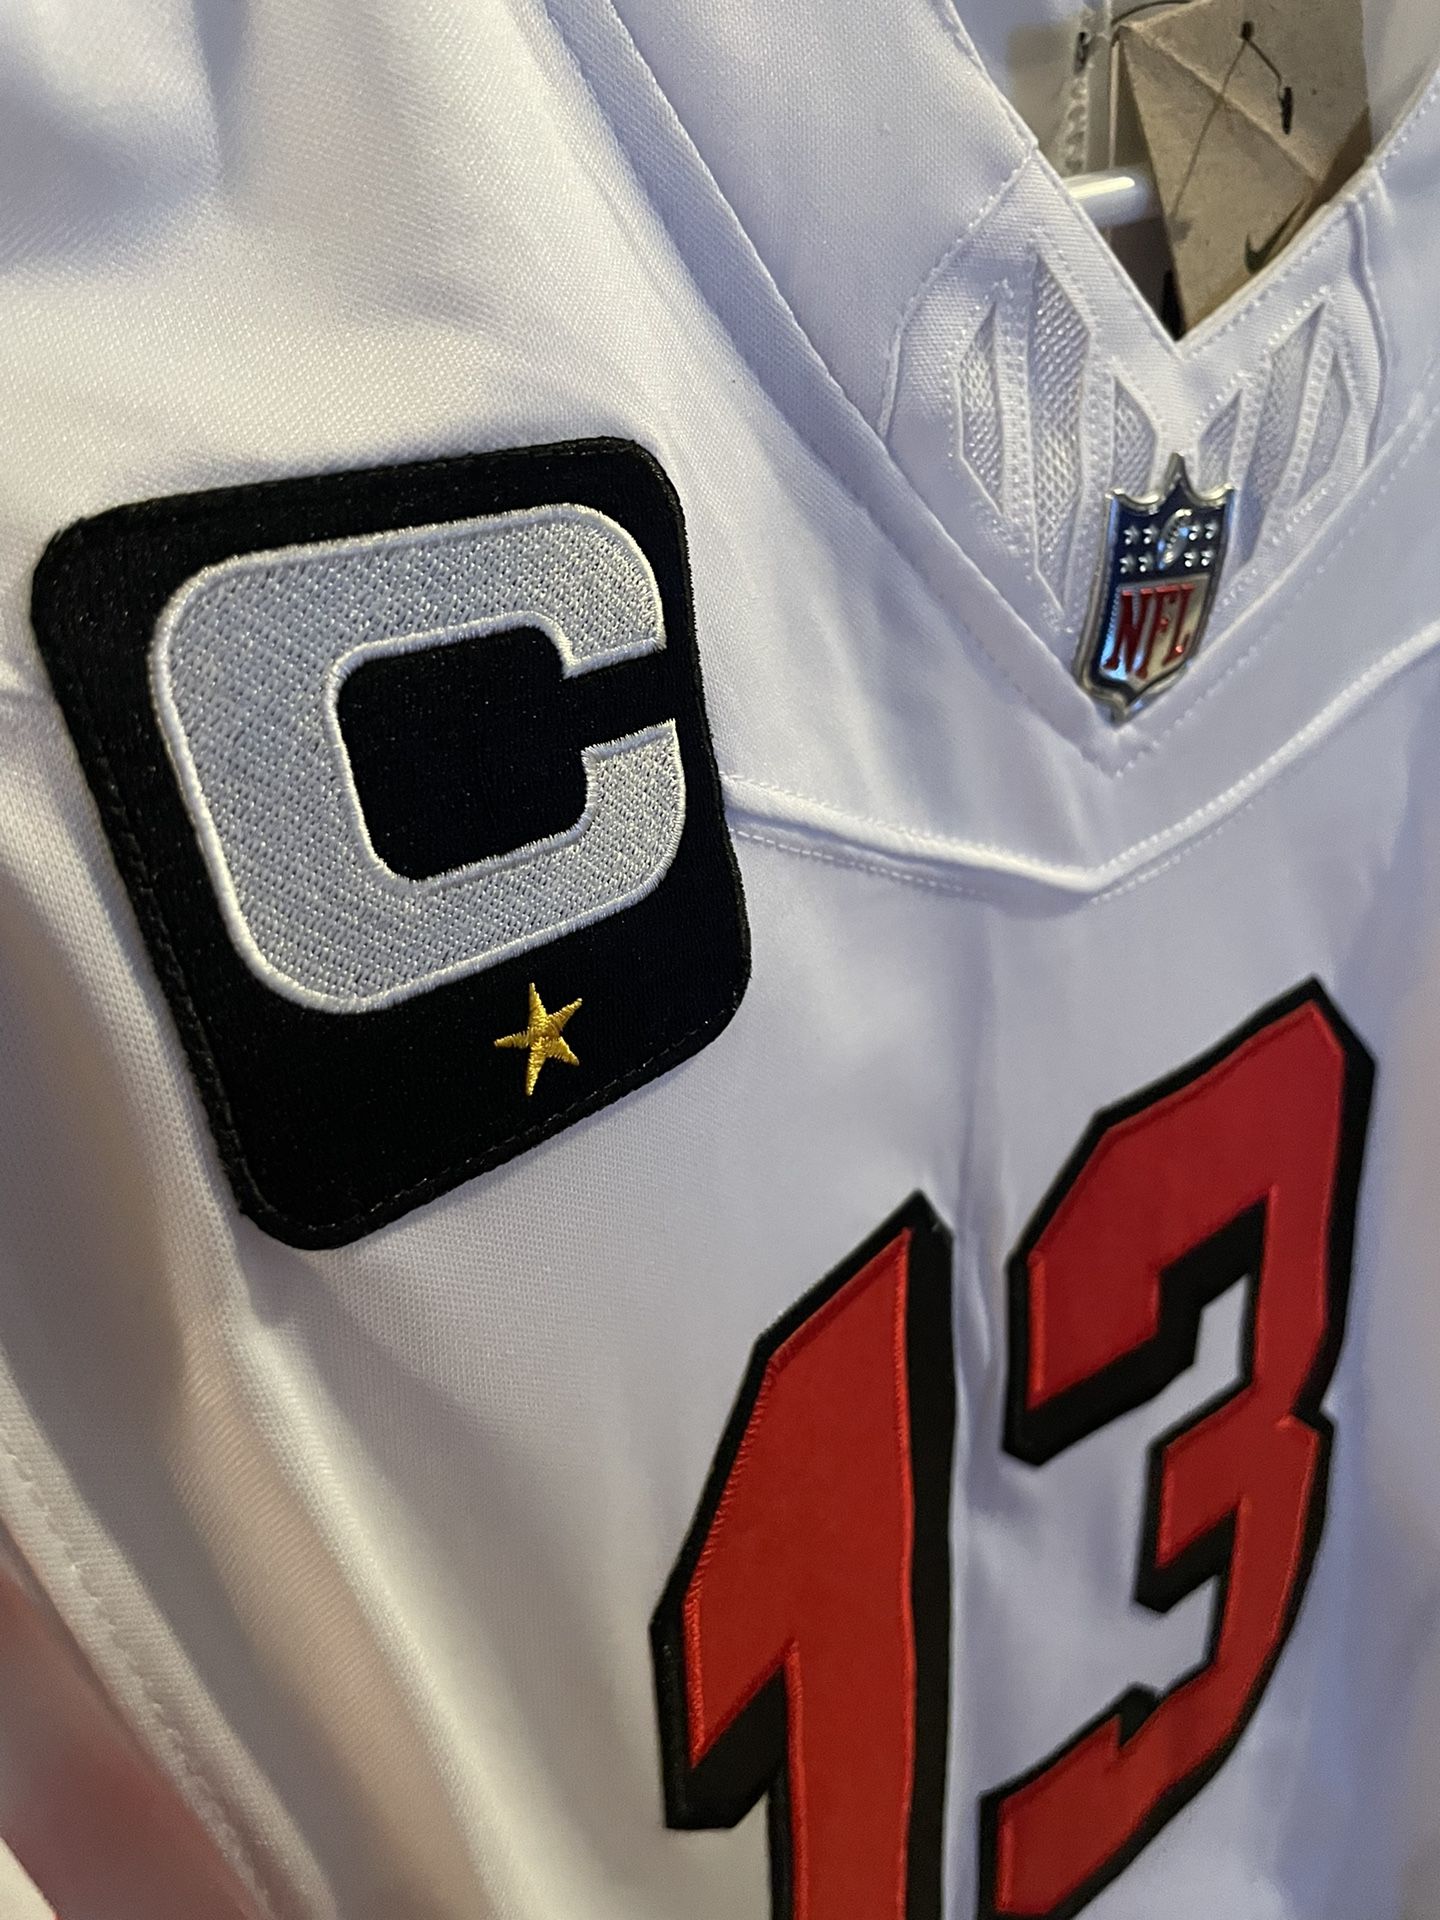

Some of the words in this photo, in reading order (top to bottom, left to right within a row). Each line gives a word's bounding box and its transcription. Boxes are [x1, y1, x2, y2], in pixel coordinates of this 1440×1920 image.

[148, 503, 686, 1014] C
[1101, 583, 1197, 680] NFL
[650, 976, 1377, 1920] 13
